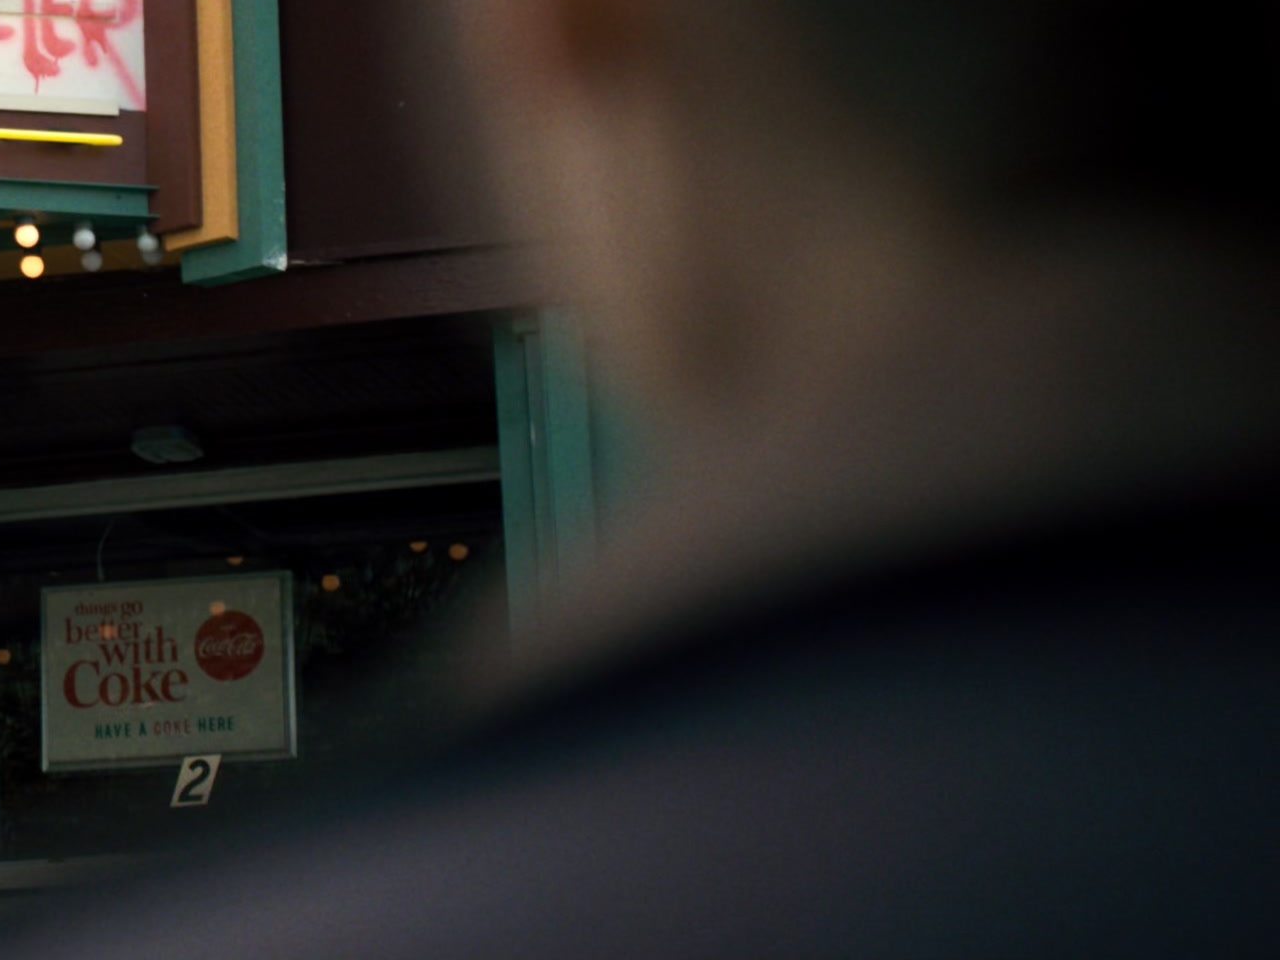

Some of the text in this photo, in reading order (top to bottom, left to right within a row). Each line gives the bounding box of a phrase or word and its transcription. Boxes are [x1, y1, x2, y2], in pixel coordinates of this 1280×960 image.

[75, 600, 143, 621] things go
[65, 617, 143, 644] better
[99, 627, 179, 667] with
[63, 659, 188, 709] Coke
[95, 716, 234, 739] HAVE A COKE HERE
[177, 758, 211, 803] 2
